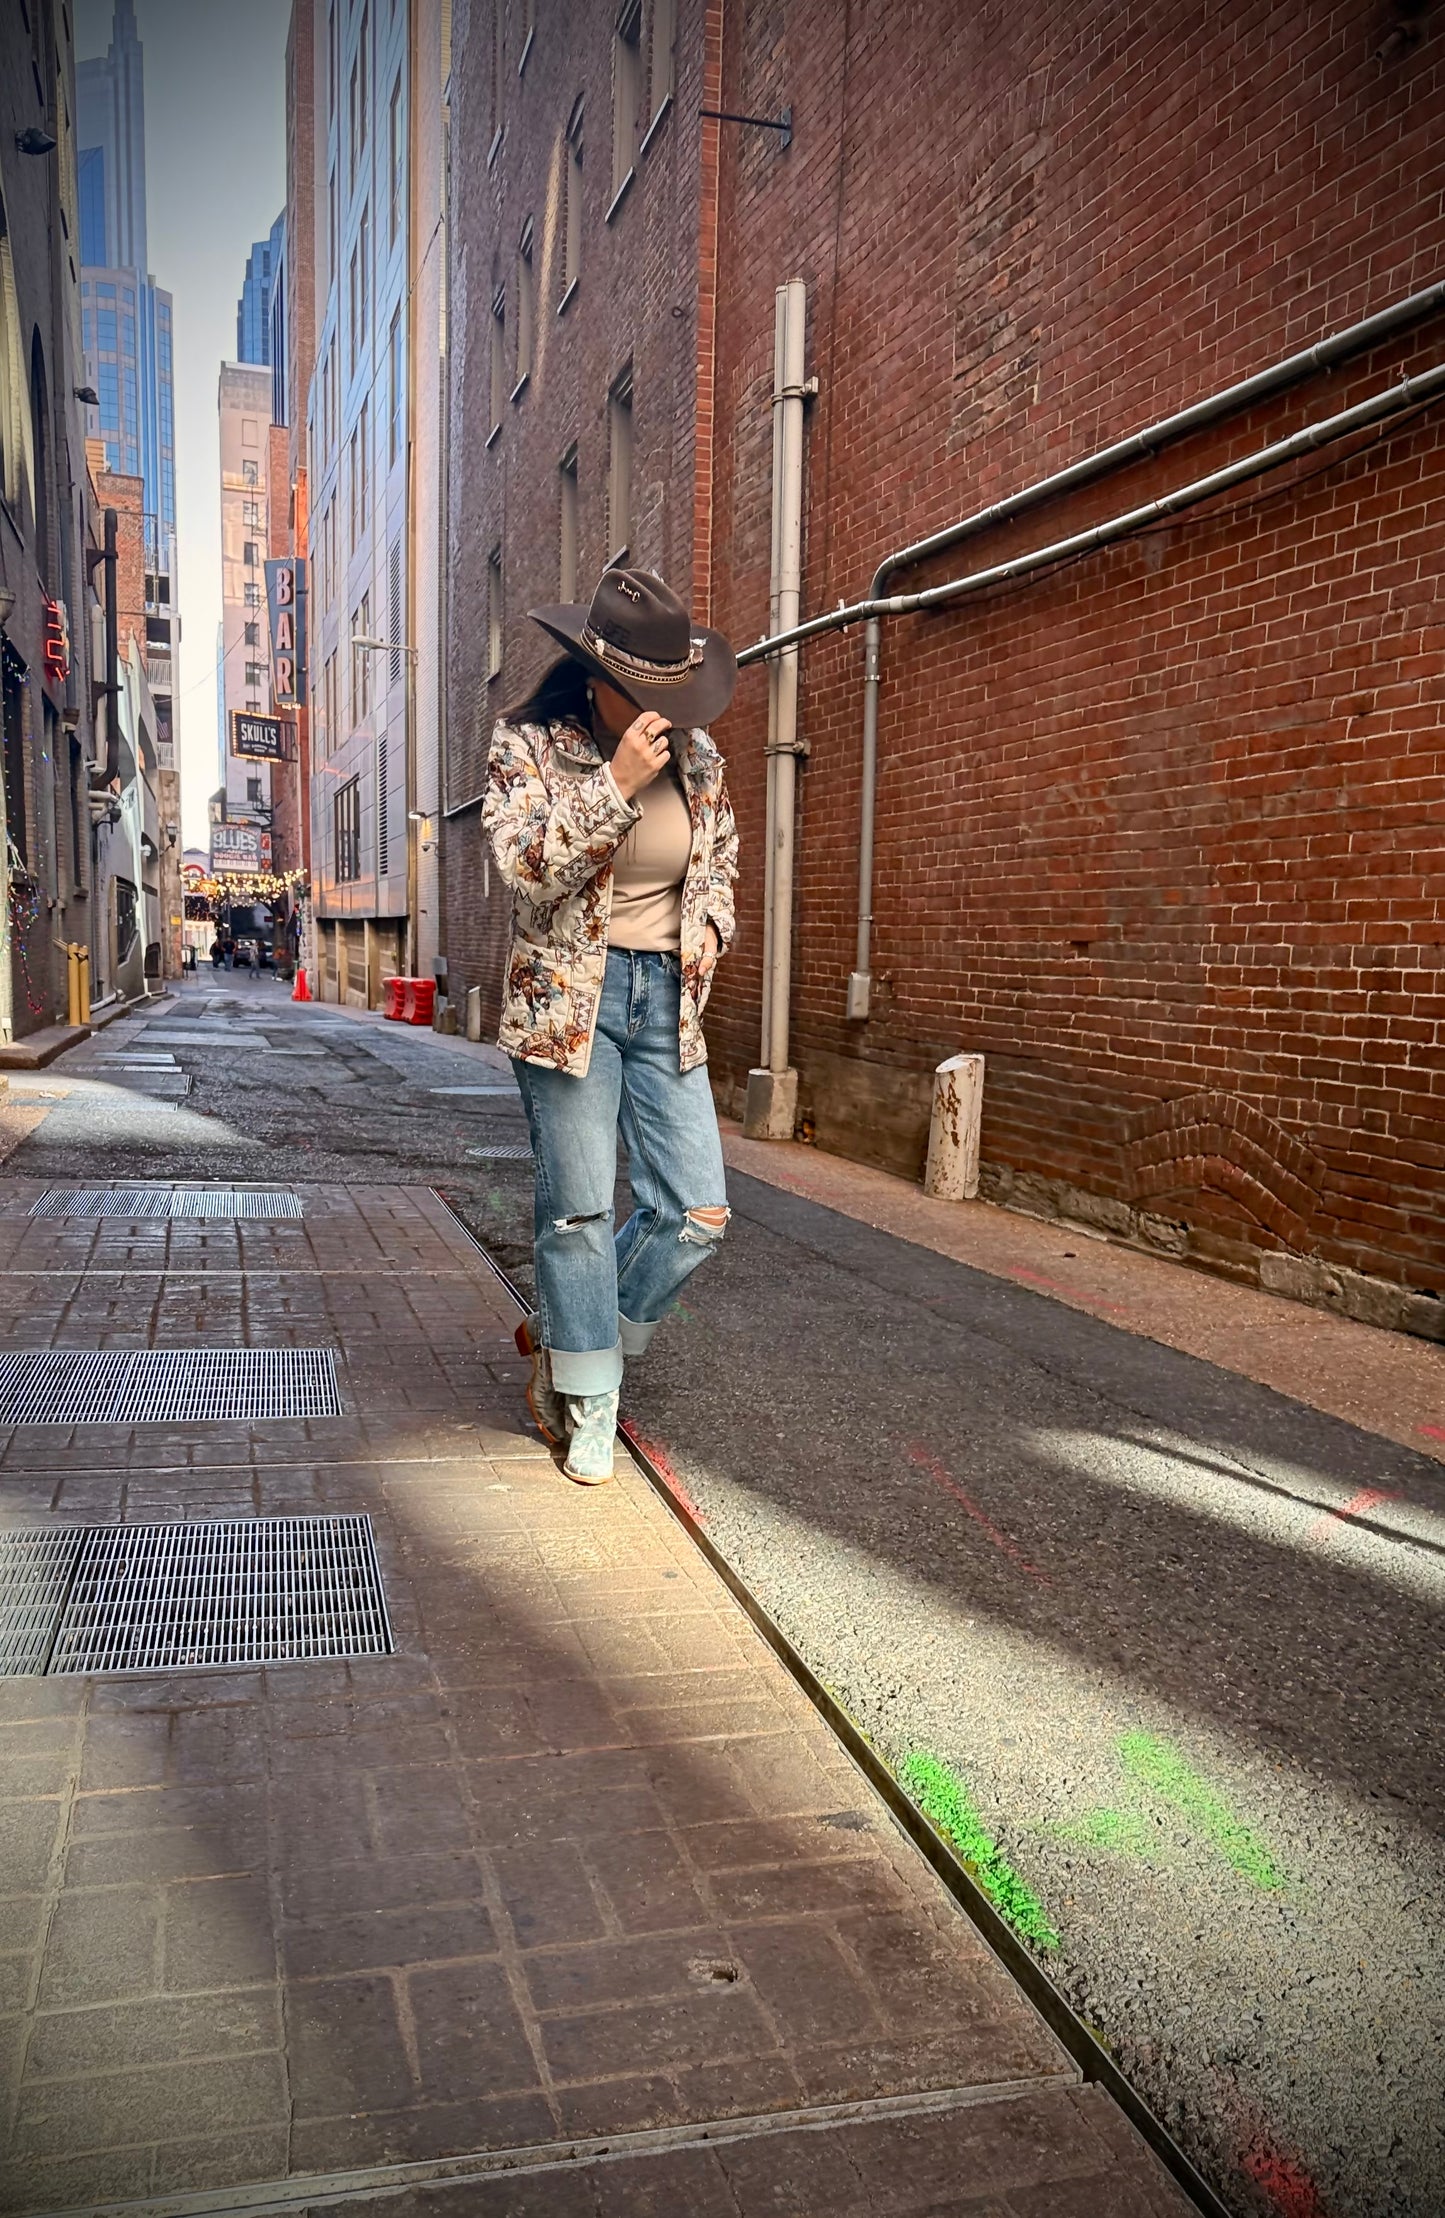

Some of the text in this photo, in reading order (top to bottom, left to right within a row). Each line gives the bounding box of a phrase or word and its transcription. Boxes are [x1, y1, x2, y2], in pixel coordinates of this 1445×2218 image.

[276, 567, 292, 694] BAR
[241, 722, 277, 746] SKULL'S
[213, 829, 257, 852] BLUES
